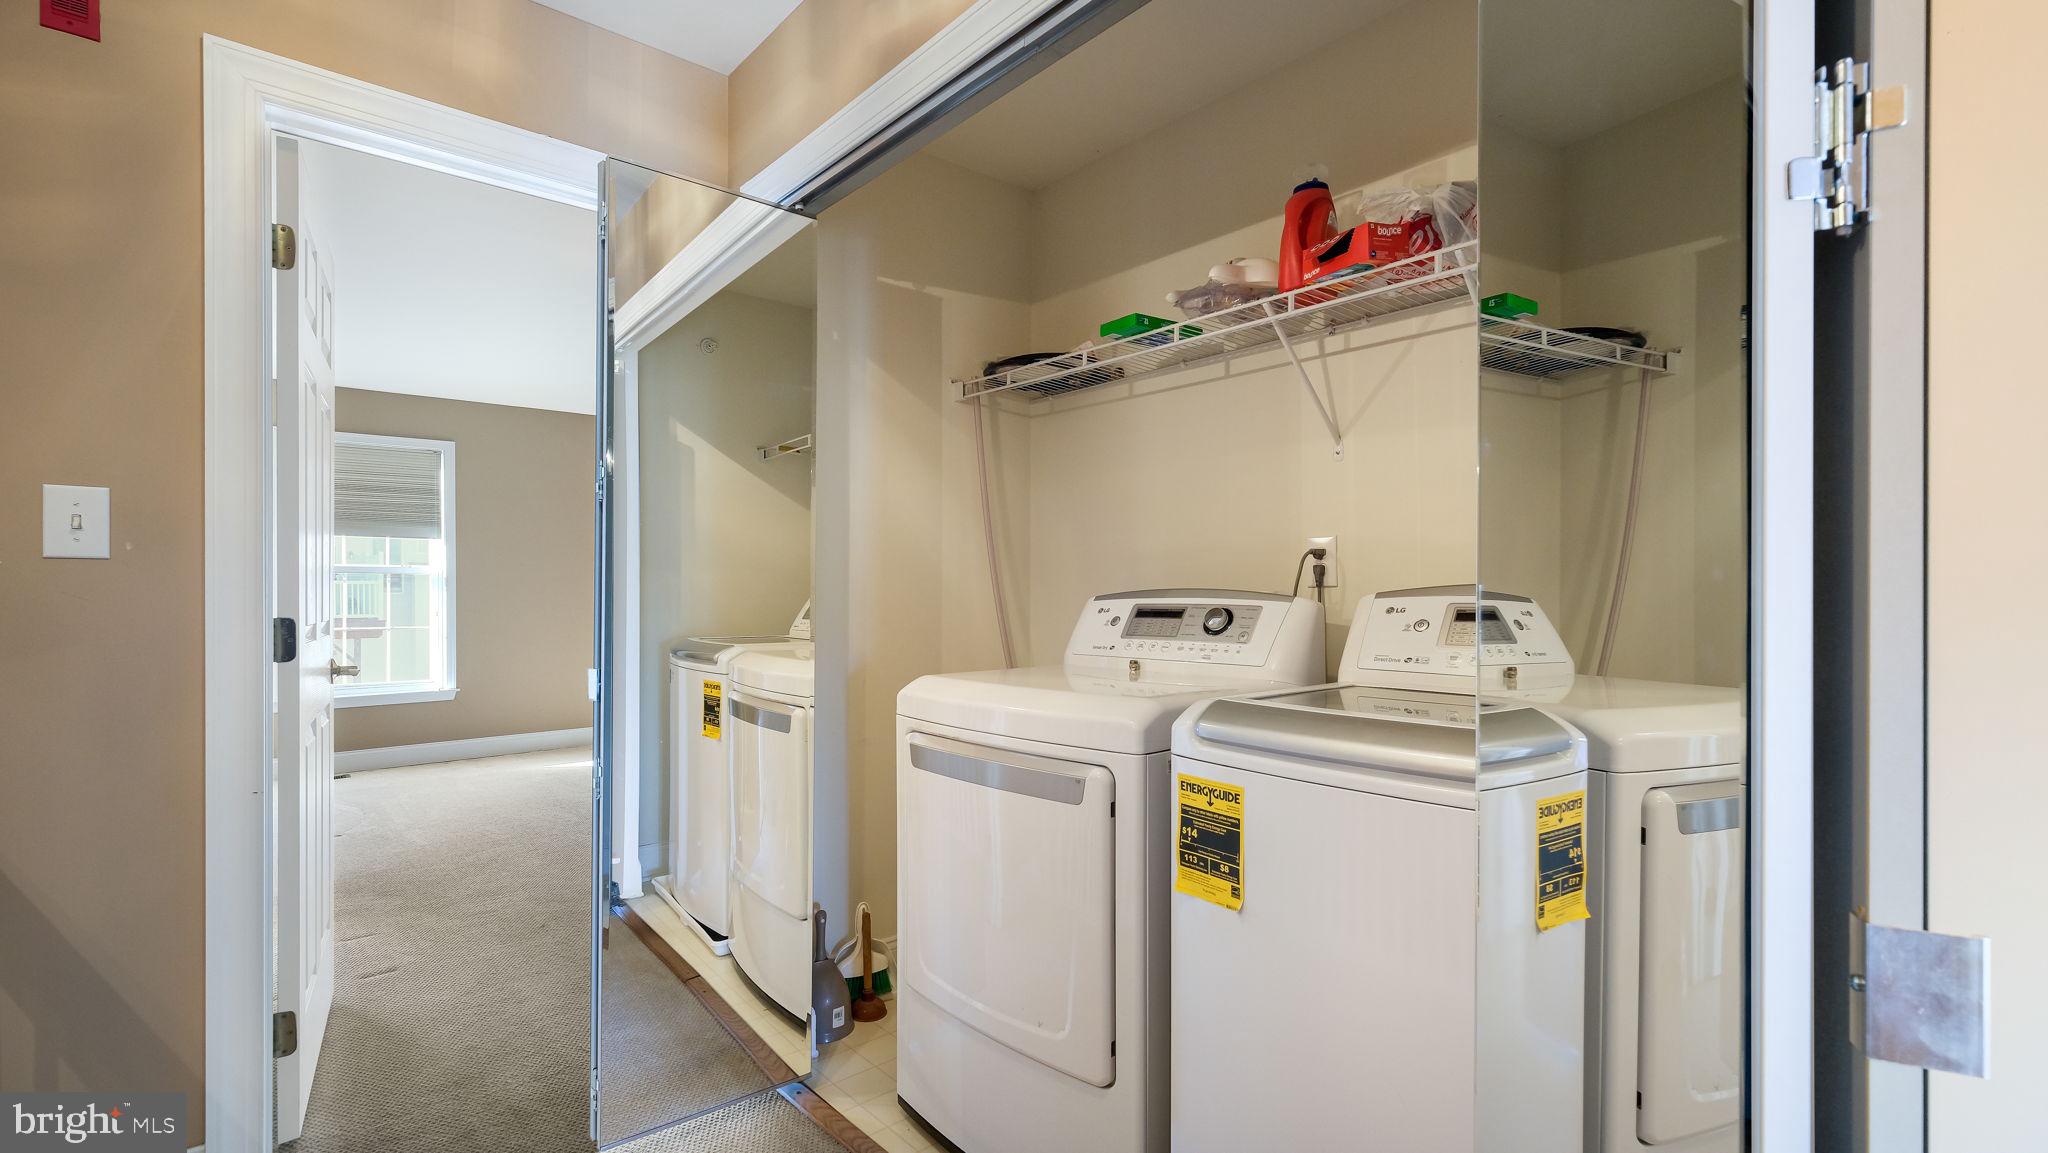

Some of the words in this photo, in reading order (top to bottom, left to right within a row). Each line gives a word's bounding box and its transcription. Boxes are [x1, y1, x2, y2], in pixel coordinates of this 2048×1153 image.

[1377, 225, 1402, 236] bounce
[1180, 780, 1241, 805] ENERGYGUIDE
[1182, 826, 1198, 839] $14
[1184, 854, 1198, 864] 113
[1220, 863, 1229, 873] $8
